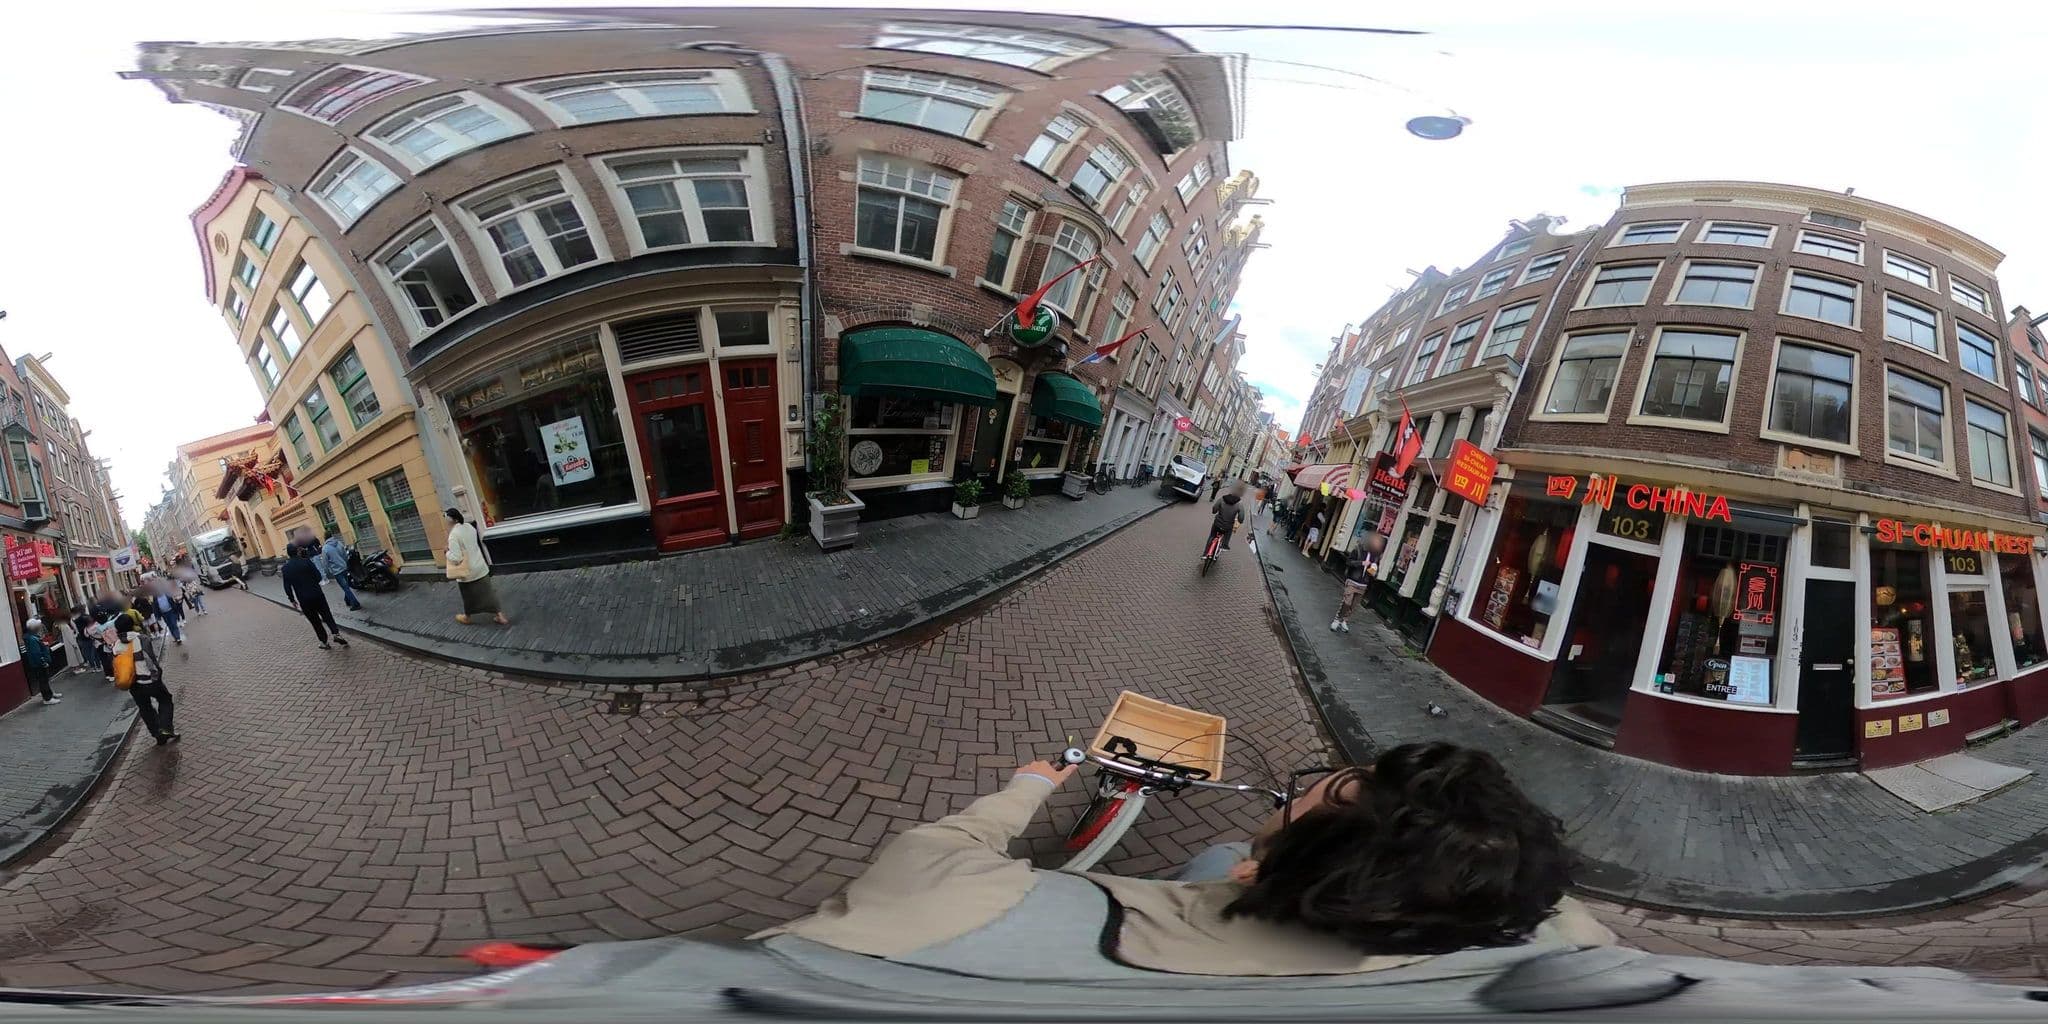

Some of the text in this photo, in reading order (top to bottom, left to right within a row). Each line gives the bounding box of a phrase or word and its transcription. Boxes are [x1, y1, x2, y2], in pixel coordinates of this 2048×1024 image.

[1375, 468, 1407, 491] Henk
[1456, 459, 1490, 481] RESTAURANT
[1454, 474, 1485, 500] 四川
[1547, 475, 1732, 522] 四川 CHINA
[1611, 516, 1649, 539] 103
[1876, 518, 1991, 552] SI-CHUAN
[1950, 557, 1976, 572] 103
[1708, 659, 1727, 669] Open
[1706, 683, 1737, 693] ENTREE
